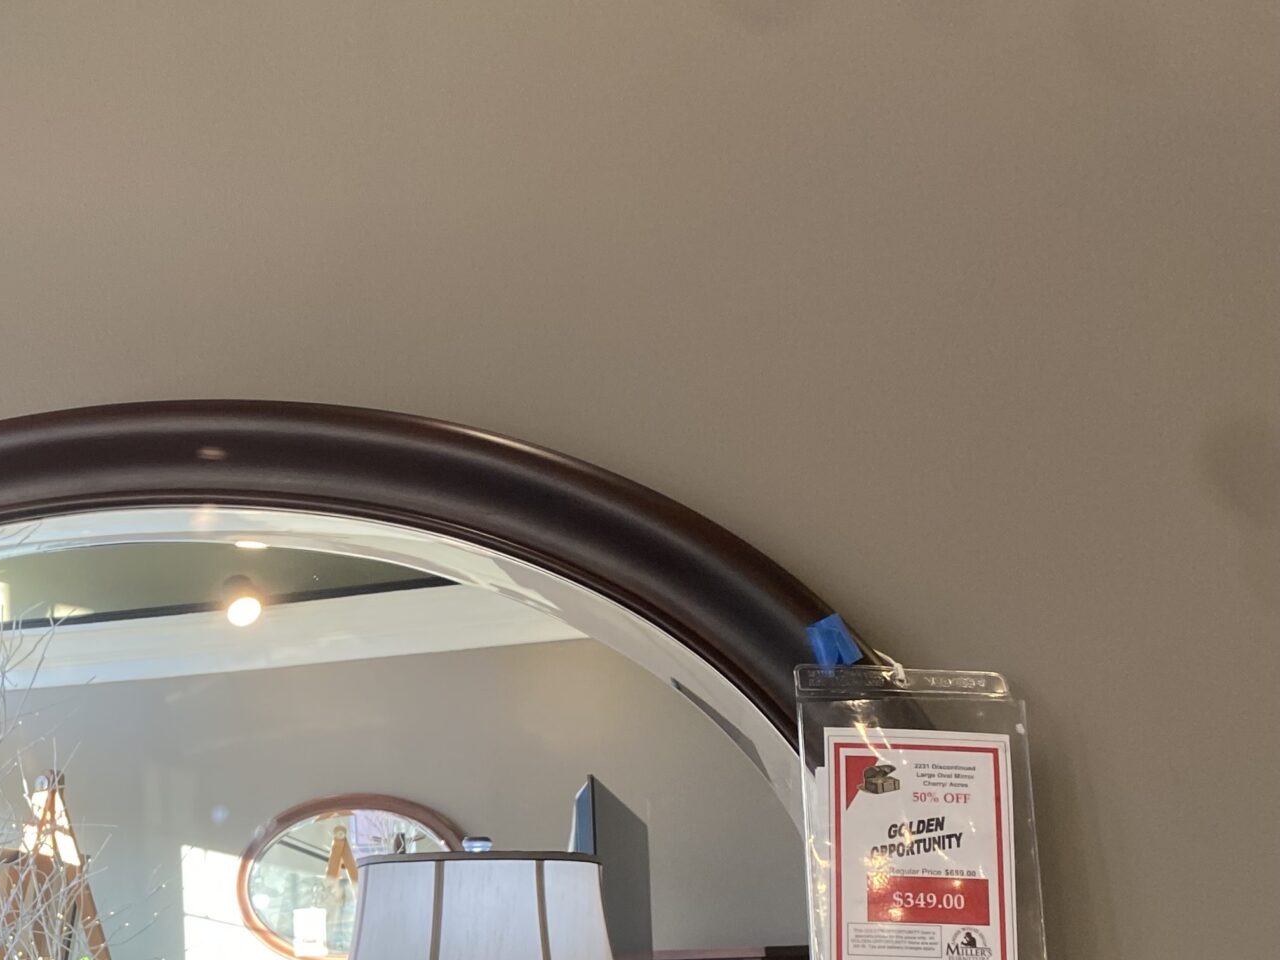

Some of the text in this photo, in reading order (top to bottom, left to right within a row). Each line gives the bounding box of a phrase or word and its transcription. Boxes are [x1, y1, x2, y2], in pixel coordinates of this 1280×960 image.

[912, 791, 971, 804] 50% OFF
[887, 816, 946, 840] GOLDEN
[870, 832, 964, 859] OPPORTUNITY
[921, 867, 942, 876] Price
[892, 891, 966, 911] $349.00
